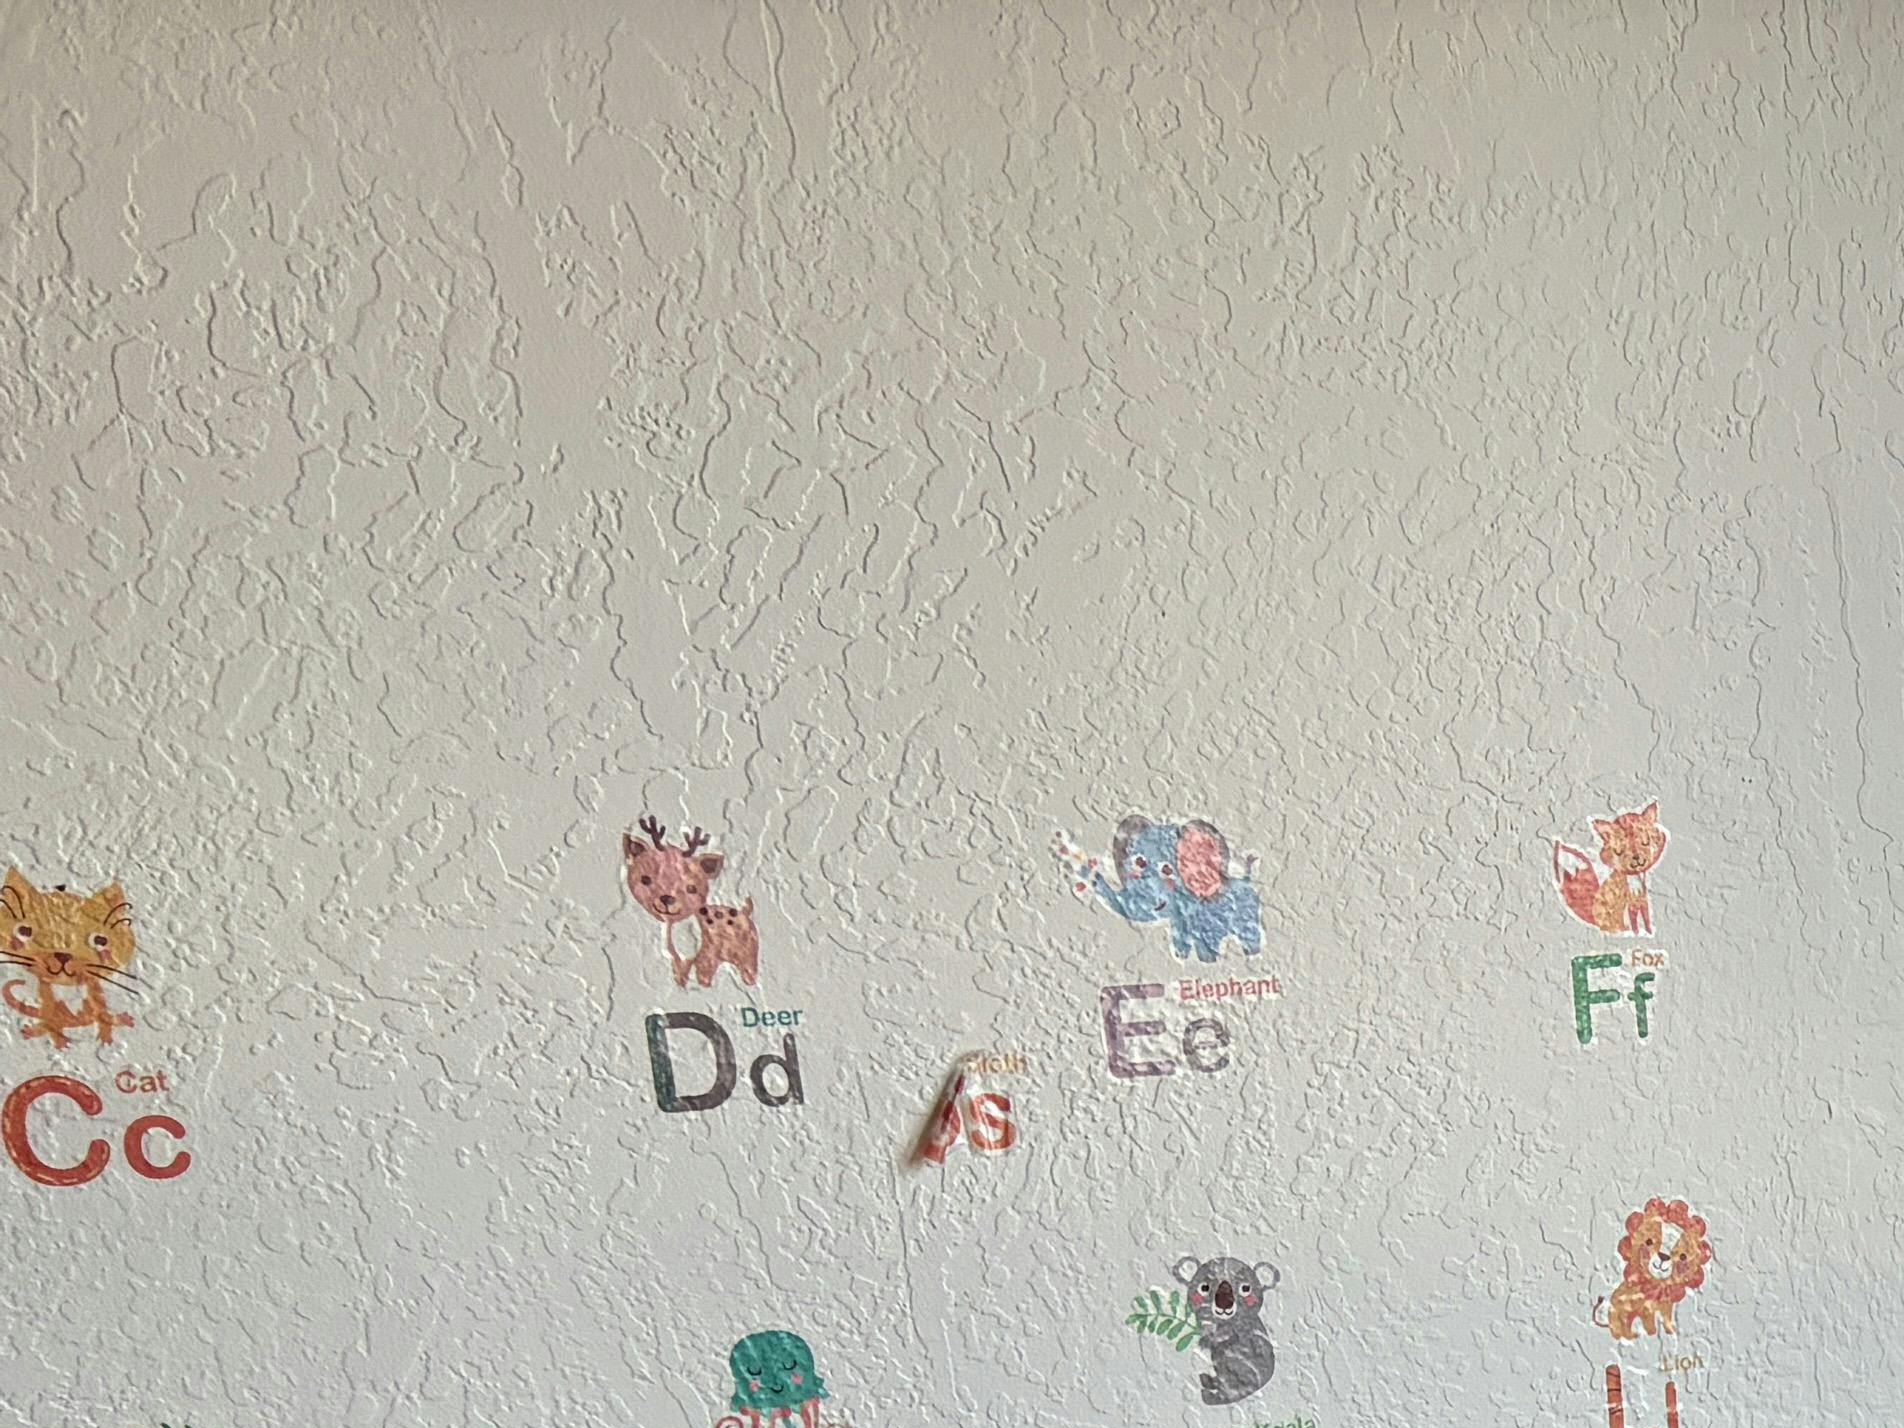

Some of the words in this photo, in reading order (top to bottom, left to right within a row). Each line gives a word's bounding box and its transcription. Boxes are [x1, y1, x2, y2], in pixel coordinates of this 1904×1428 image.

[1631, 949, 1665, 969] Fox
[1178, 975, 1281, 1002] Elephant
[1571, 953, 1655, 1045] Ff
[742, 1005, 804, 1028] Deer
[1101, 983, 1231, 1078] Ee
[645, 1011, 804, 1112] Dd
[115, 1071, 168, 1094] Cat
[1, 1075, 192, 1187] Cc
[1661, 1353, 1705, 1374] Lion
